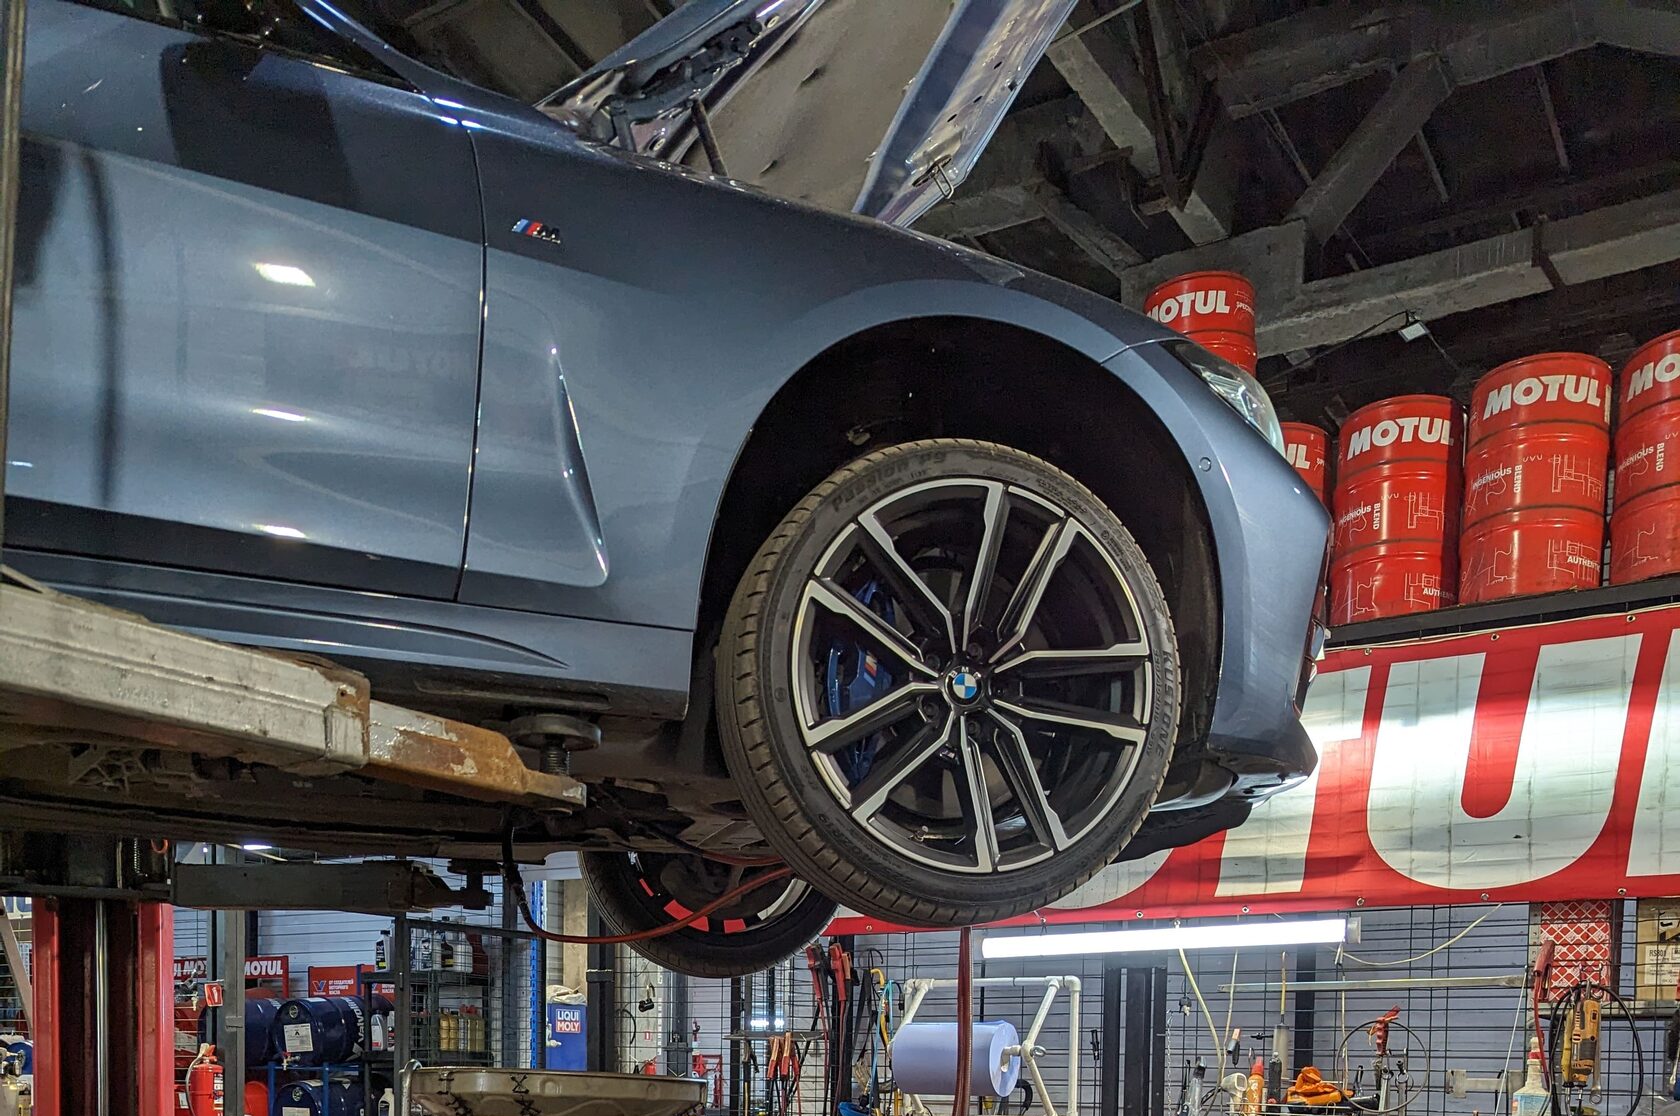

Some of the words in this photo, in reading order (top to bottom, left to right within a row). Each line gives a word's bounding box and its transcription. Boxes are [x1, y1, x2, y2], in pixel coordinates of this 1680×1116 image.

[1627, 353, 1680, 402] MO
[1483, 374, 1601, 421] MOTUL
[1347, 417, 1455, 461] MOTUL
[1656, 442, 1665, 472] BLEND
[1472, 466, 1512, 491] INGENIOUS
[1513, 464, 1523, 494] BLEND
[1372, 502, 1381, 530] BLEND
[556, 1021, 580, 1032] MOLY
[557, 1010, 579, 1021] LIQUI
